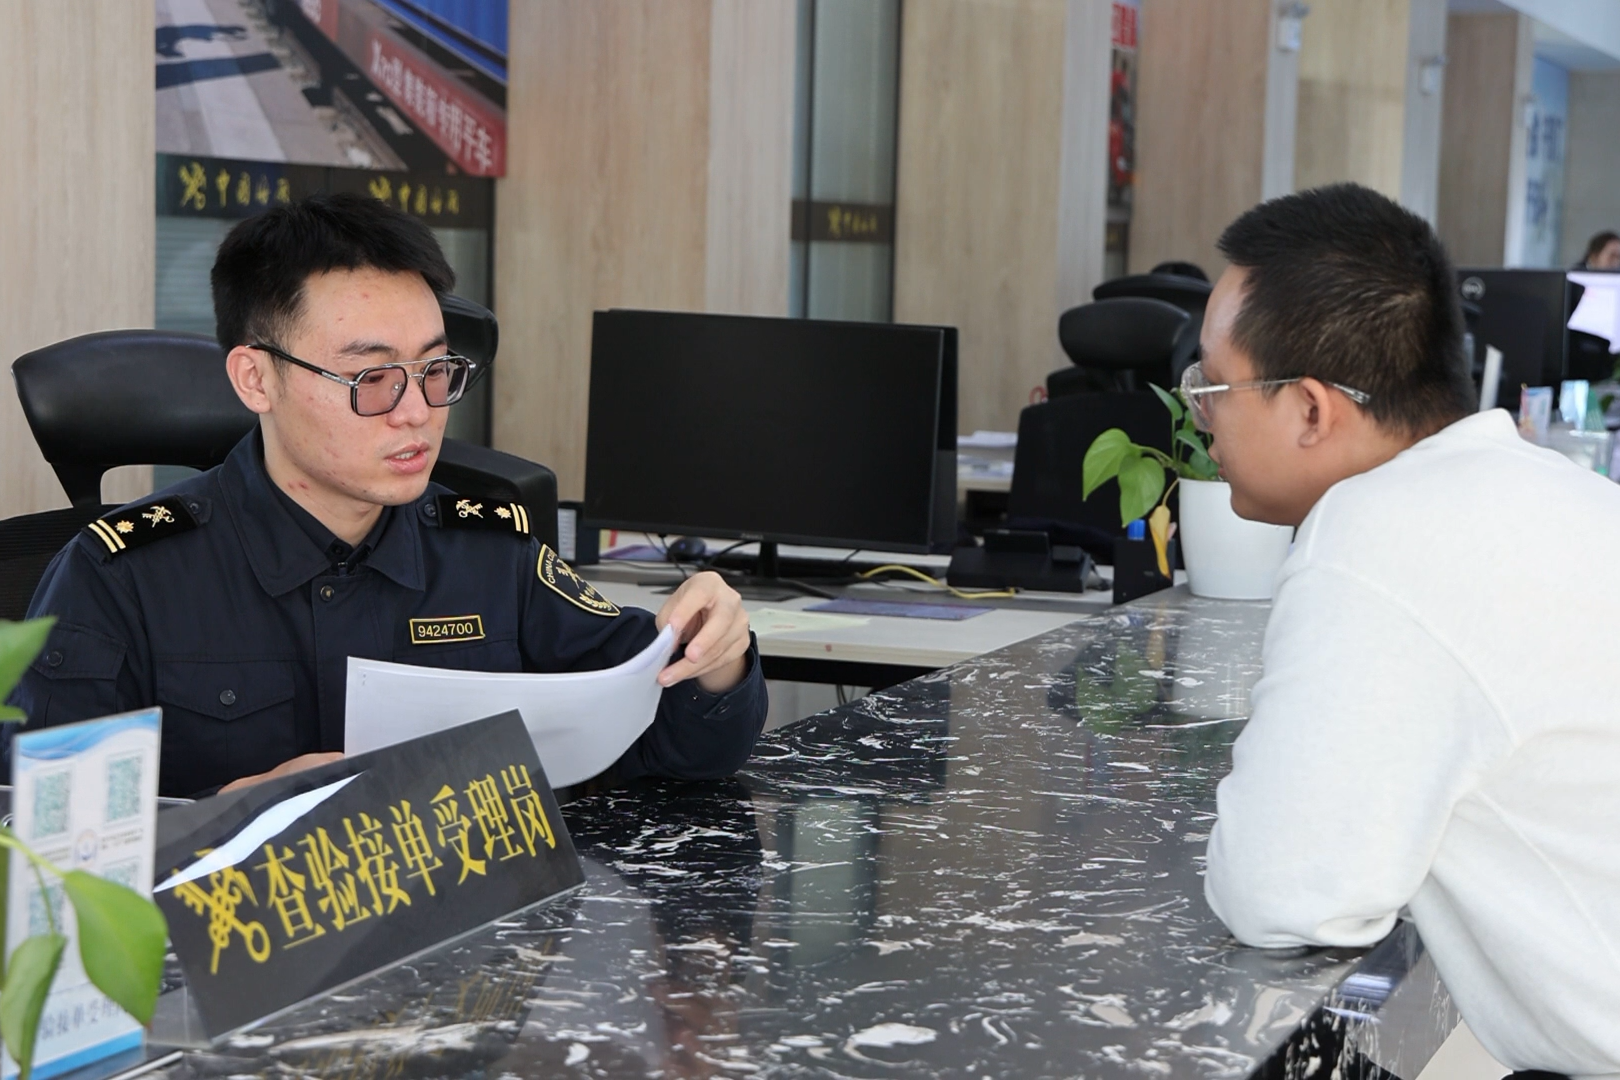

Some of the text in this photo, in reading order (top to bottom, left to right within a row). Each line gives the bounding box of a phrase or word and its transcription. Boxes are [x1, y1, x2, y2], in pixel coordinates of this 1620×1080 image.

[417, 622, 474, 637] 9424700
[255, 764, 556, 950] 查验接单受理岗
